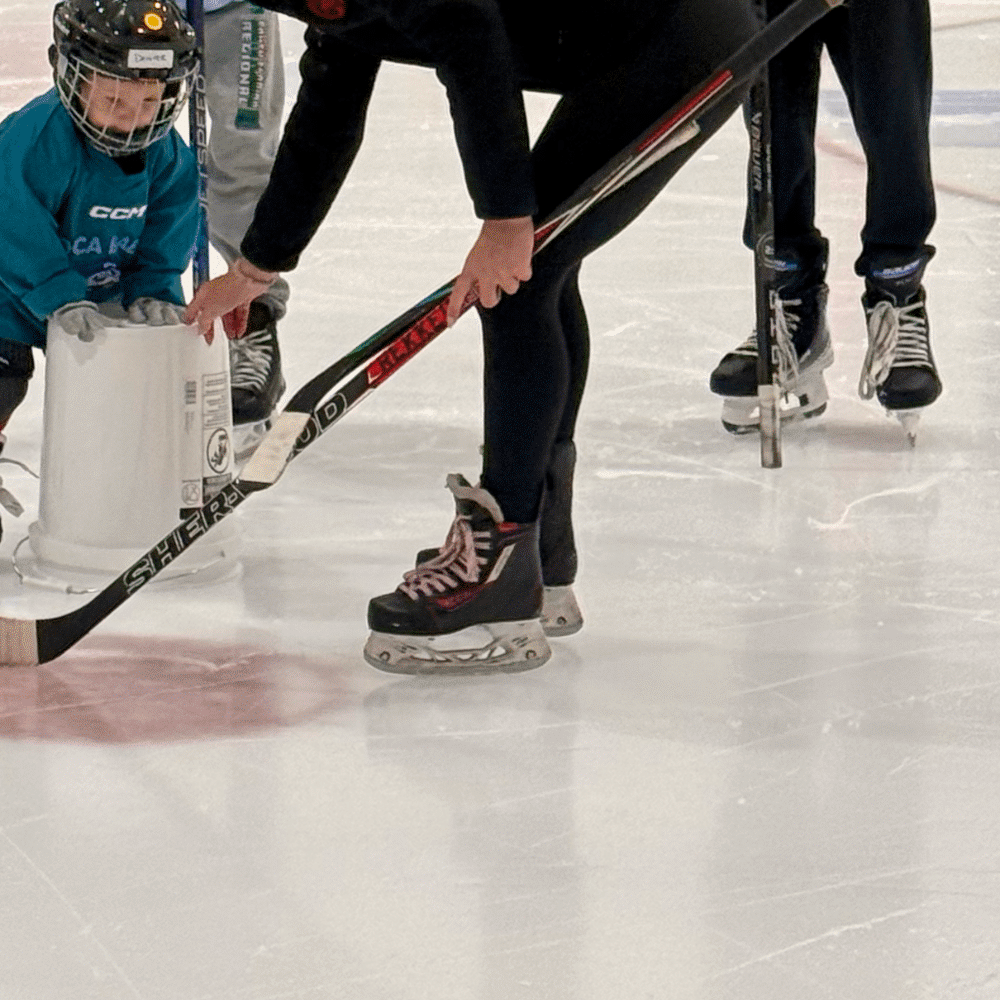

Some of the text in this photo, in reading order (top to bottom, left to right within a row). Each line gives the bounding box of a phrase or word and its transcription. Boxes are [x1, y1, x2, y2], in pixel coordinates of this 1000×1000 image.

[238, 21, 252, 104] REGIONAL
[195, 73, 210, 212] JETSPEED
[89, 205, 148, 219] CCM
